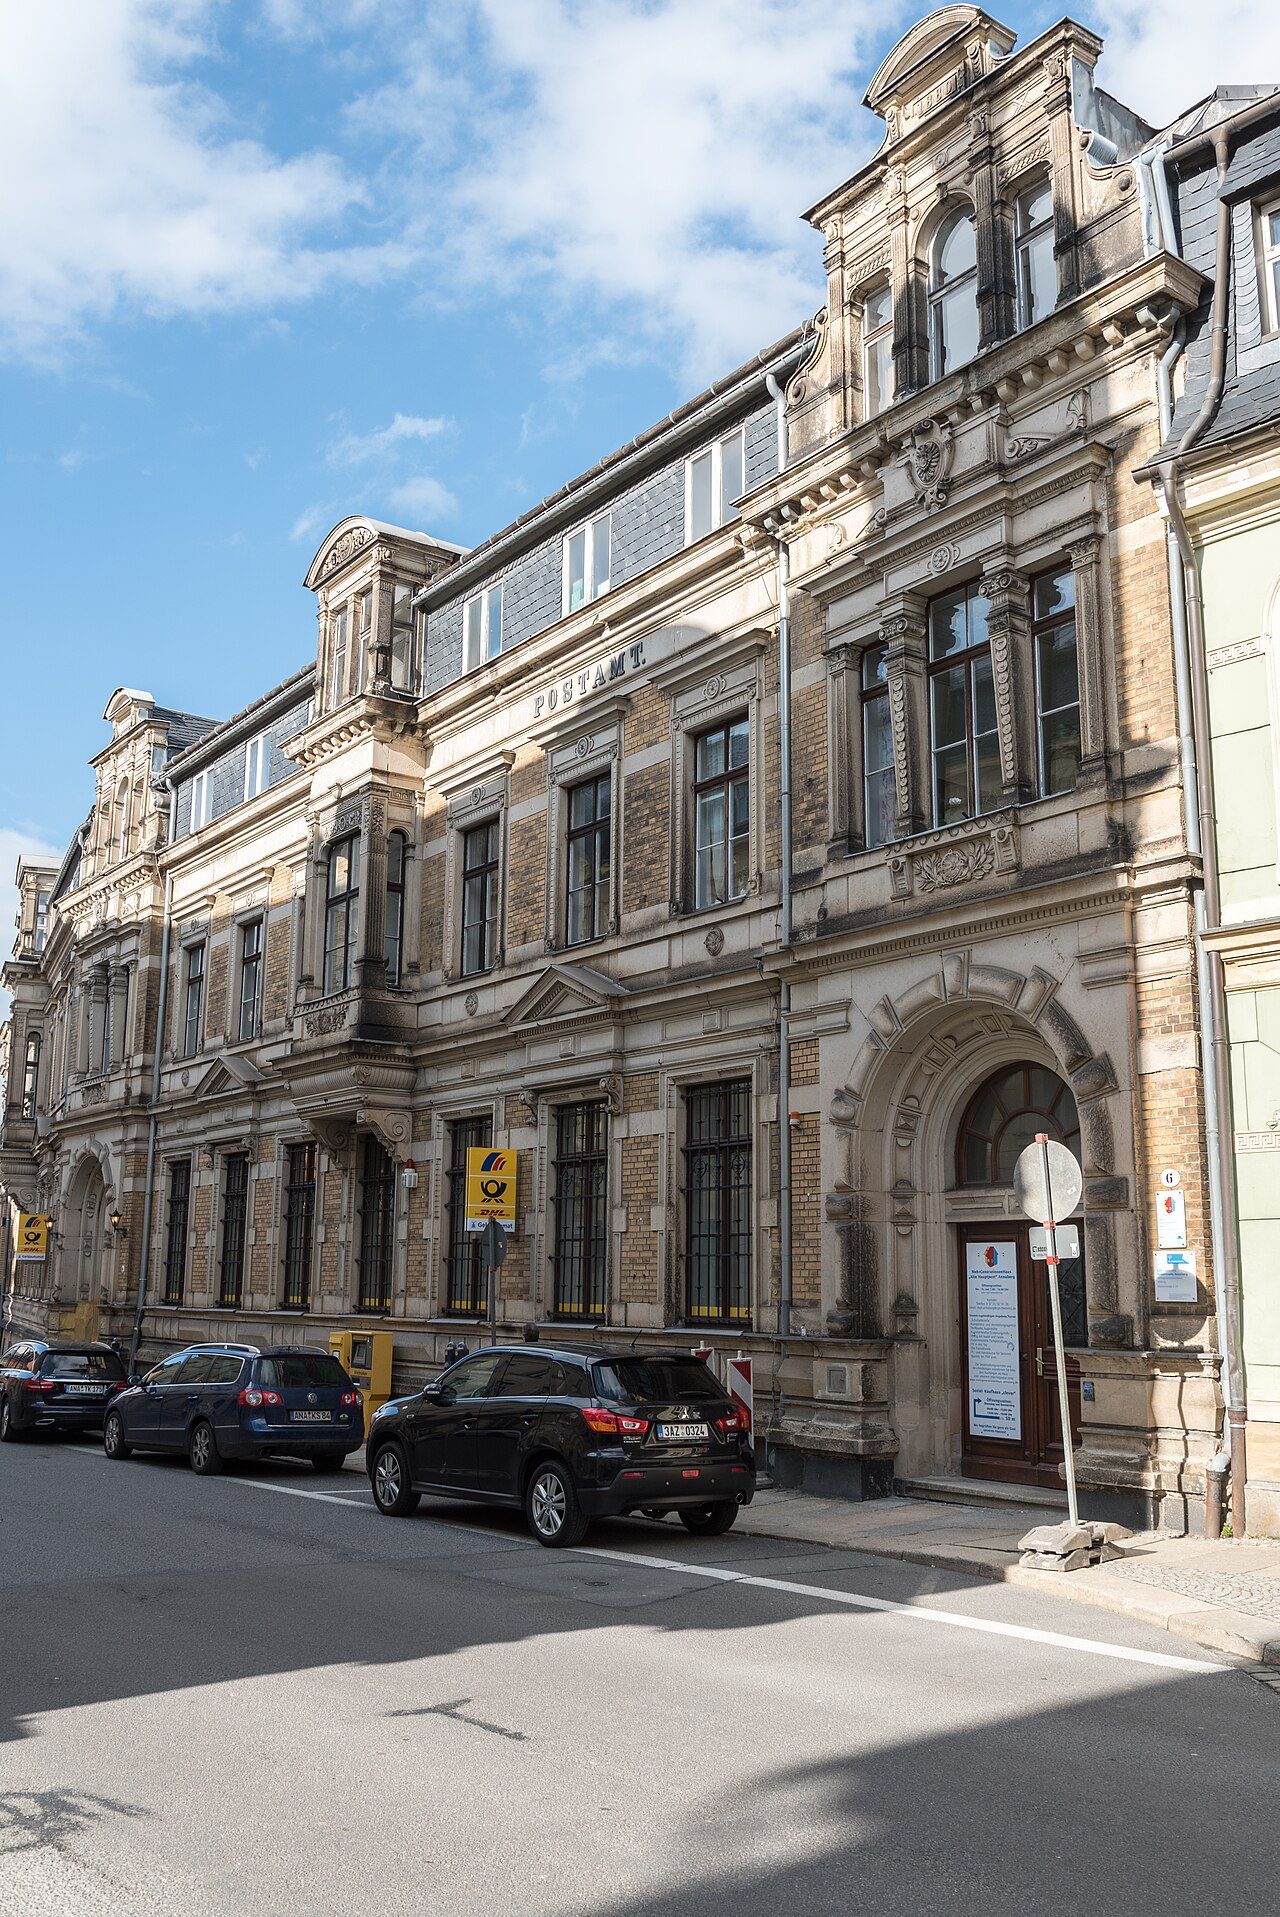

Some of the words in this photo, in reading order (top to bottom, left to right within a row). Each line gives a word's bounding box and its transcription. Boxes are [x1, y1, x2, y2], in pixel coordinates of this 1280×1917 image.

[533, 641, 646, 718] POSTAMT.
[1165, 1172, 1173, 1183] 6
[294, 1411, 308, 1419] ANA
[664, 1425, 680, 1436] 3AZ
[685, 1425, 705, 1436] 0324
